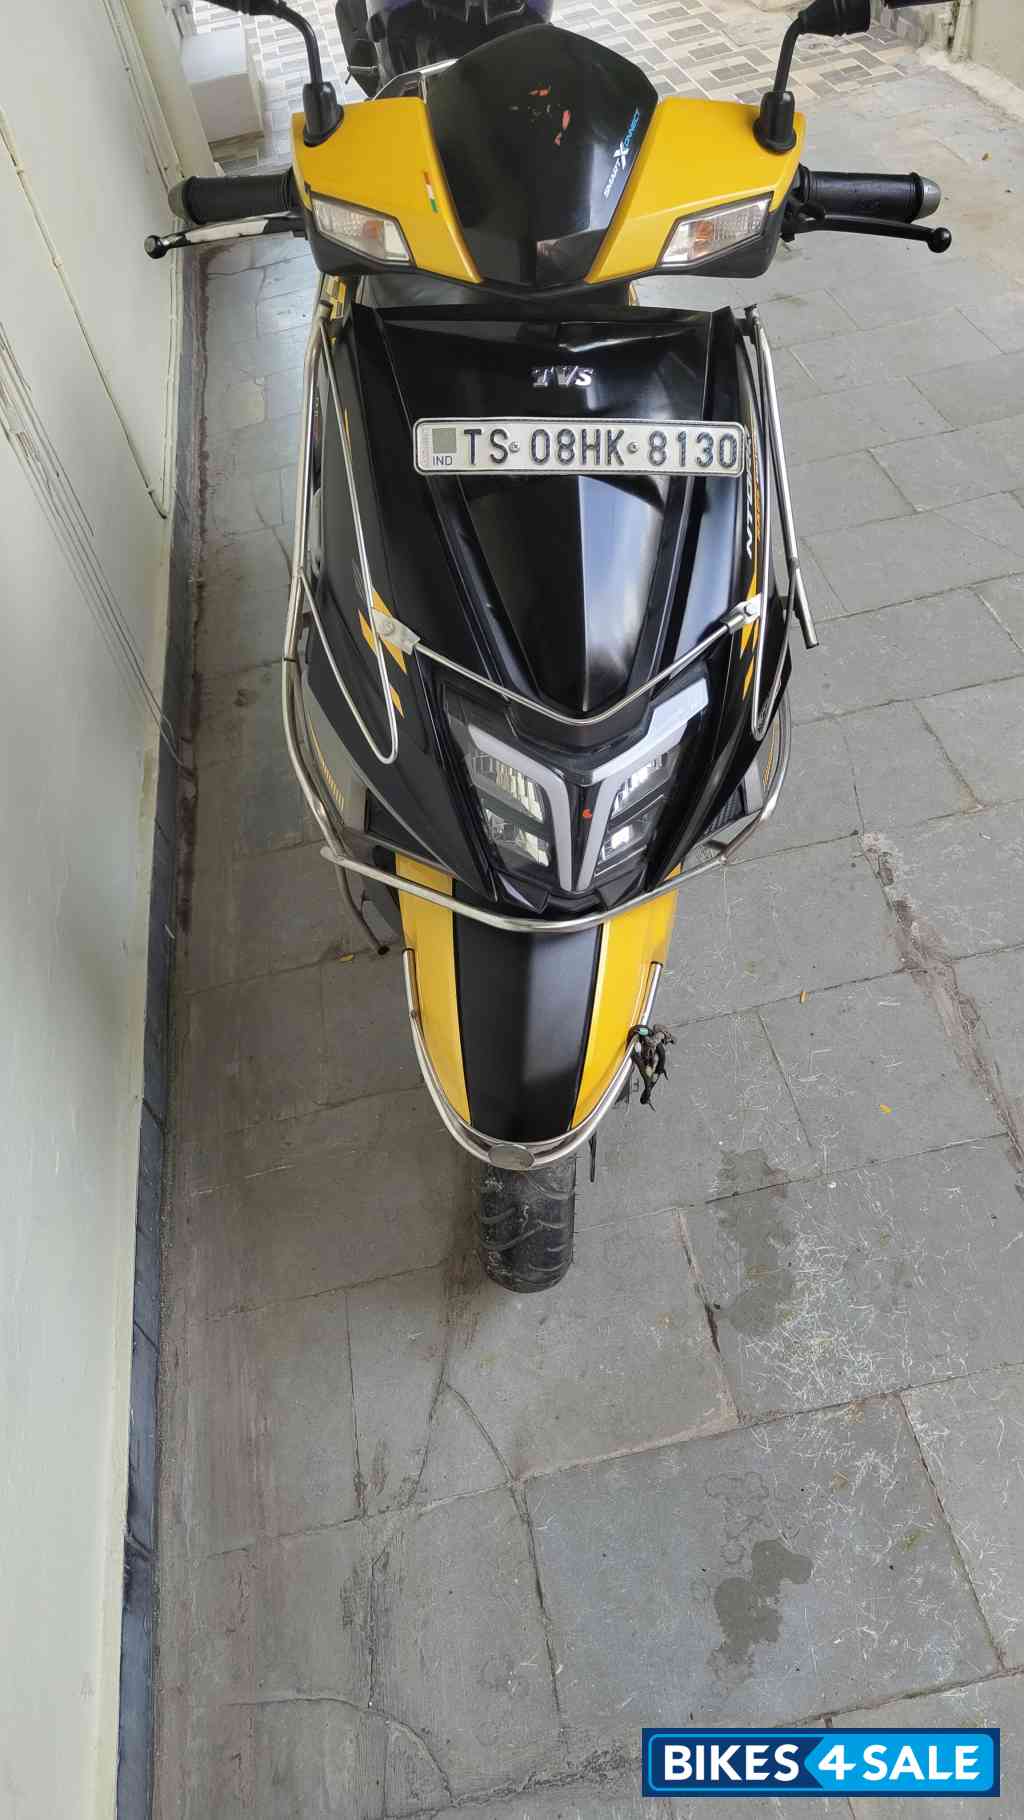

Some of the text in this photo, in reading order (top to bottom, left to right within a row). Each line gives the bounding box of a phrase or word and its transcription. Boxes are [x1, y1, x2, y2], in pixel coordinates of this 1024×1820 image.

[532, 366, 594, 387] TVS
[464, 428, 509, 465] TS
[531, 428, 625, 465] 08HK
[649, 430, 738, 468] 8130
[432, 455, 453, 466] IND
